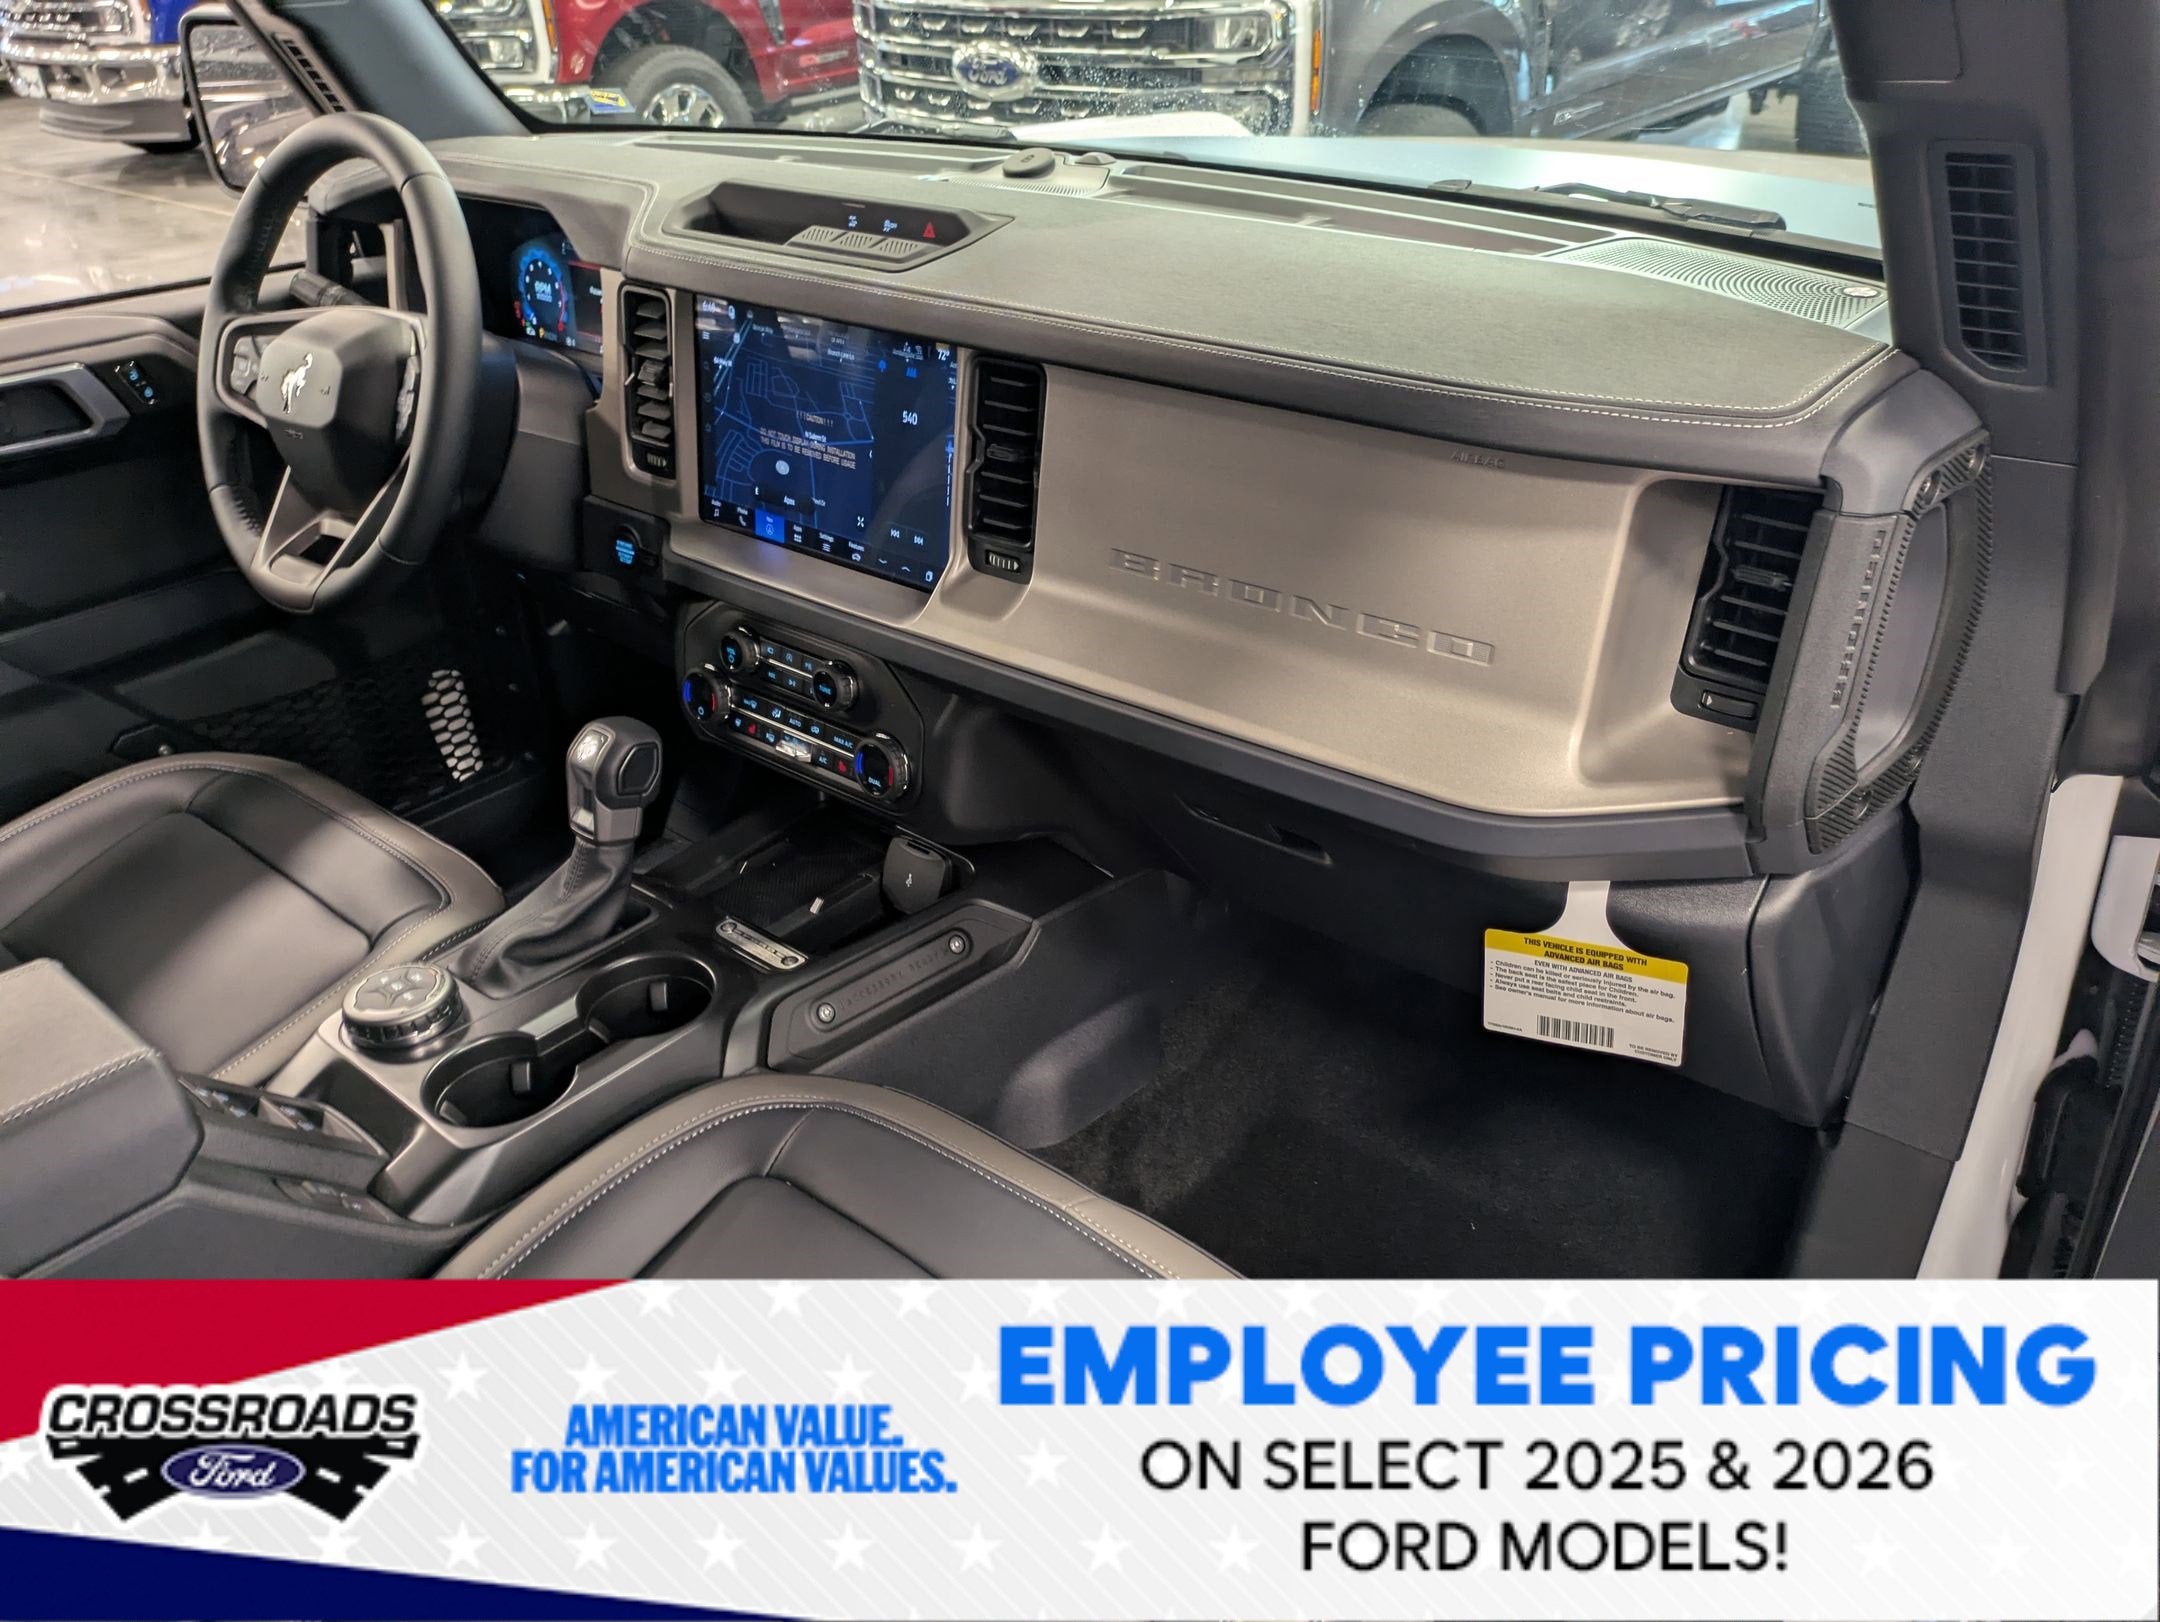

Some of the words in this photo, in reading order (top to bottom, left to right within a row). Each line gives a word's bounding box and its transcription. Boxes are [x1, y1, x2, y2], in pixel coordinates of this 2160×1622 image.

[902, 410, 918, 426] 540
[822, 453, 840, 465] BEFORE
[827, 445, 856, 460] INSTALLATION
[1109, 548, 1496, 667] BRONCO
[788, 717, 802, 728] AUTO
[818, 755, 828, 765] A/C
[867, 775, 882, 787] DUAL
[1524, 937, 1541, 947] THIS
[1543, 940, 1574, 953] VEHICLE
[1576, 946, 1584, 955] IS
[1586, 948, 1624, 962] EQUIPPED
[1626, 956, 1647, 966] WITH
[1544, 950, 1585, 964] ADVANCED
[1587, 958, 1601, 967] AIR
[1603, 960, 1624, 971] BAGS
[1495, 960, 1522, 969] Children
[1545, 969, 1562, 978] killed
[1572, 975, 1602, 985] seriously
[1508, 968, 1524, 976] back
[1558, 978, 1577, 986] safest
[1534, 959, 1550, 968] EVEN
[1551, 963, 1568, 971] WITH
[1569, 966, 1601, 977] ADVANCED
[1603, 971, 1614, 979] AIR
[1615, 974, 1633, 983] BAGS
[1495, 972, 1513, 980] Never
[1545, 982, 1565, 991] facing
[1566, 985, 1582, 993] child
[1583, 988, 1598, 996] seat
[1606, 992, 1618, 1000] the
[1495, 978, 1517, 988] Always
[1531, 985, 1545, 993] seat
[1545, 987, 1562, 995] belts
[1576, 993, 1593, 1001] child
[1495, 984, 1507, 992] See
[1533, 991, 1557, 1001] manual
[1567, 998, 1585, 1006] more
[1586, 1000, 1624, 1013] information
[1624, 1008, 1645, 1017] about
